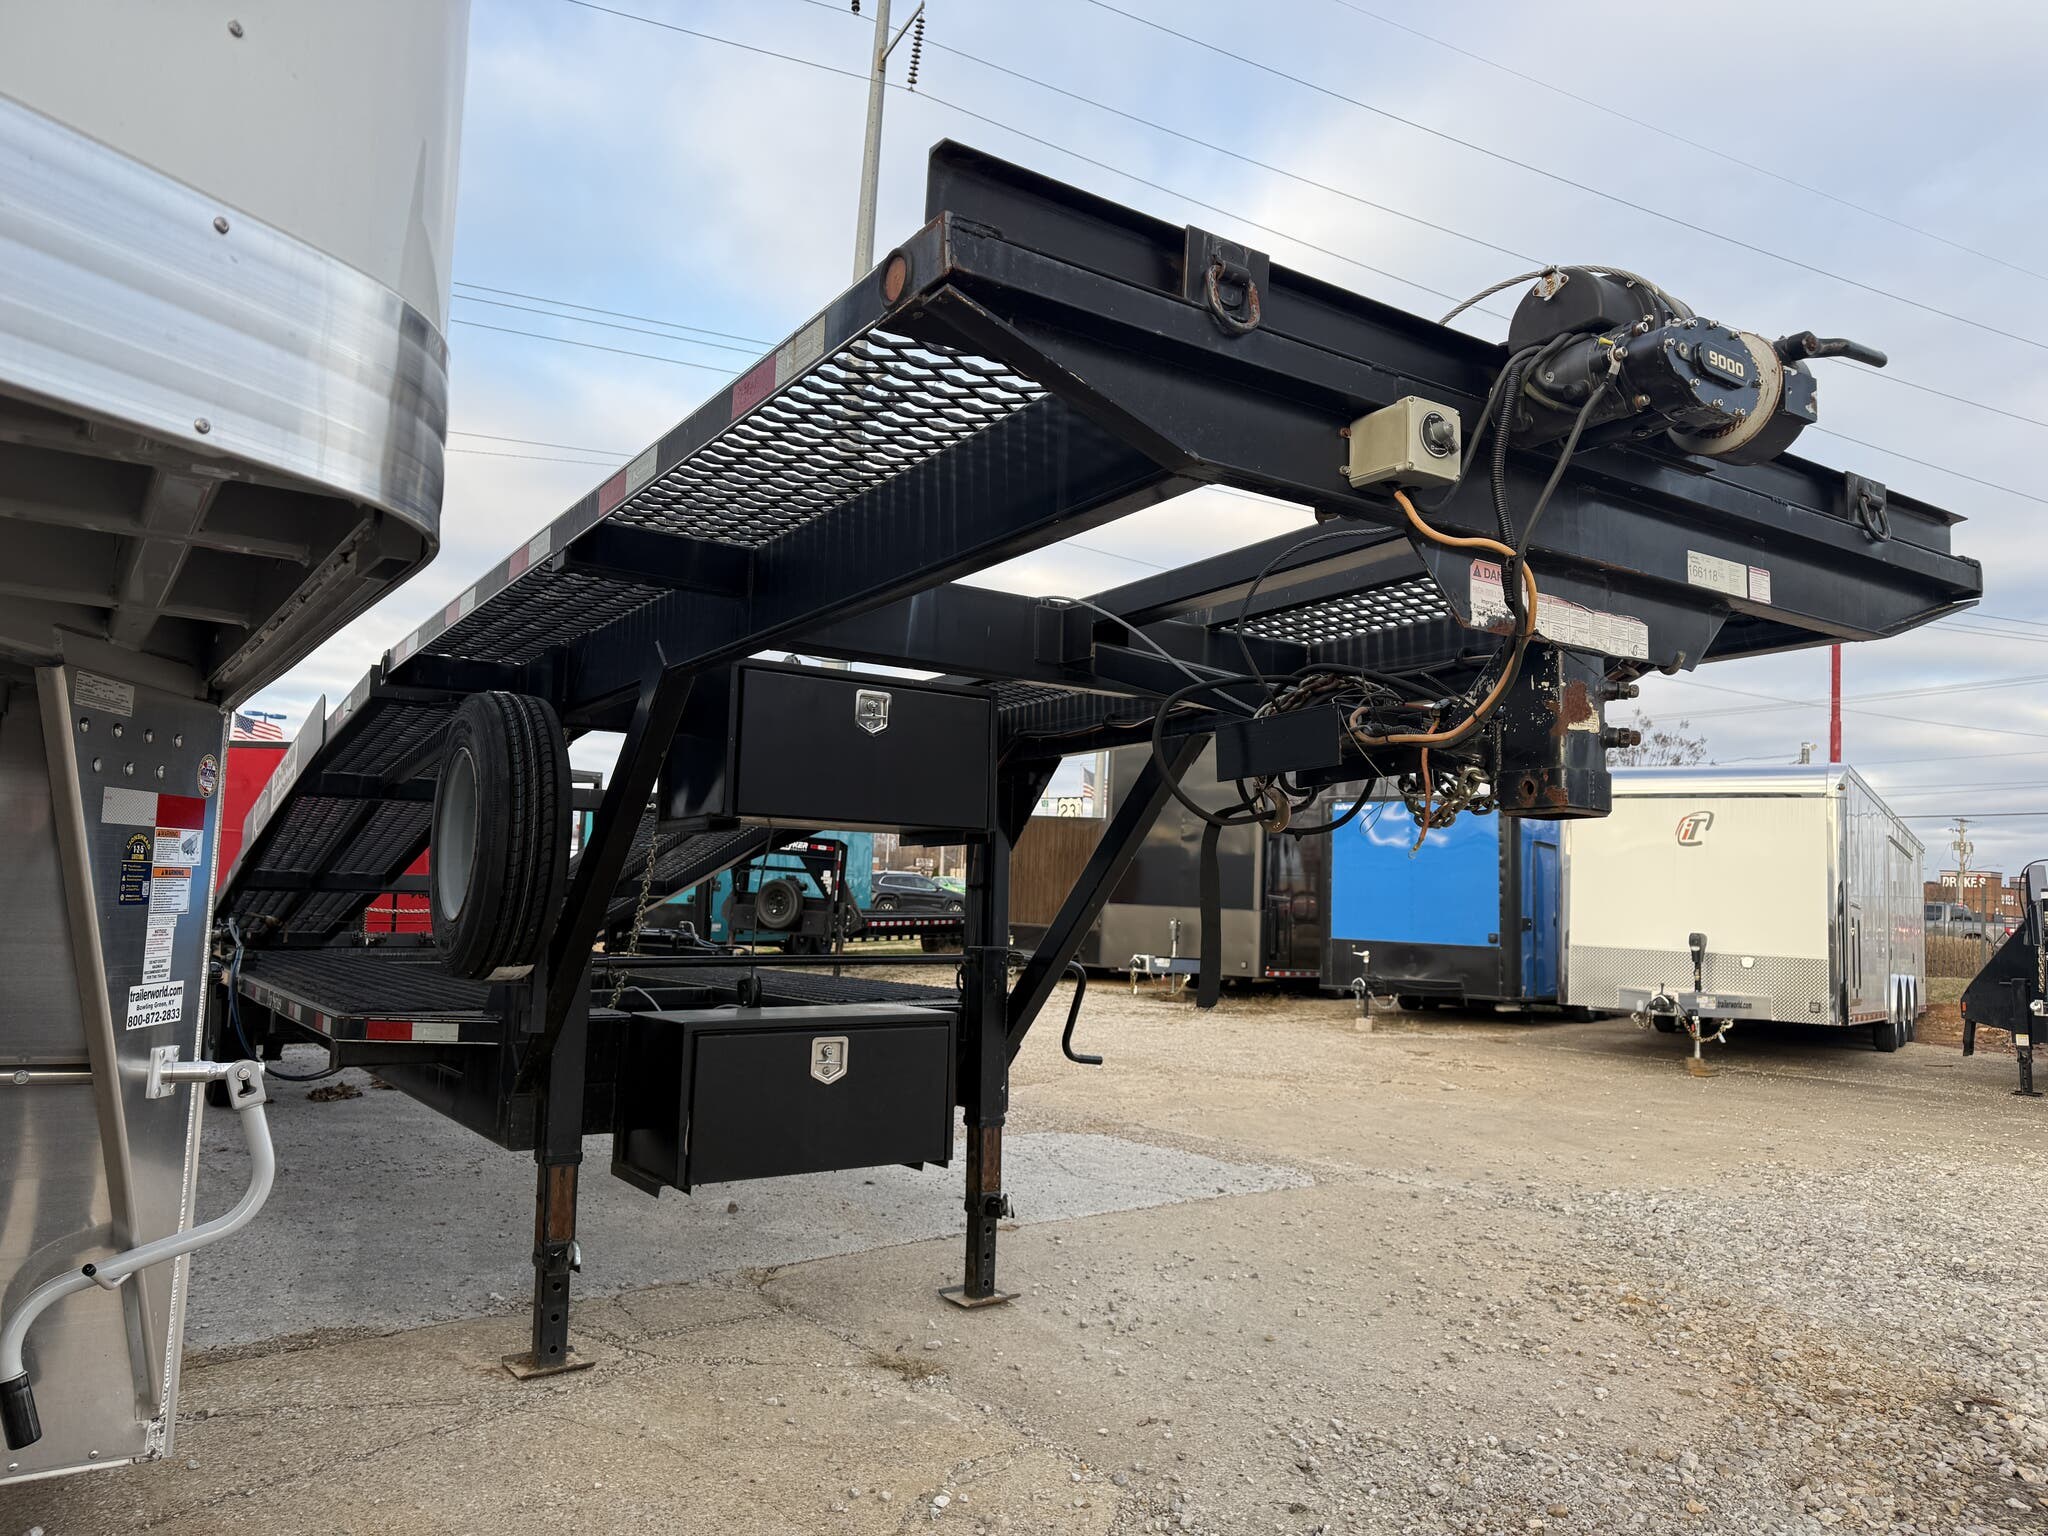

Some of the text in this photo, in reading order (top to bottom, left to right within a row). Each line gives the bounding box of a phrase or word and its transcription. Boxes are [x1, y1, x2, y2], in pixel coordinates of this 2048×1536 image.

[1709, 350, 1745, 377] 9000
[130, 985, 182, 1002] trailerworld.com
[136, 1003, 154, 1011] Bowling
[127, 1008, 180, 1027] 800-872-2833
